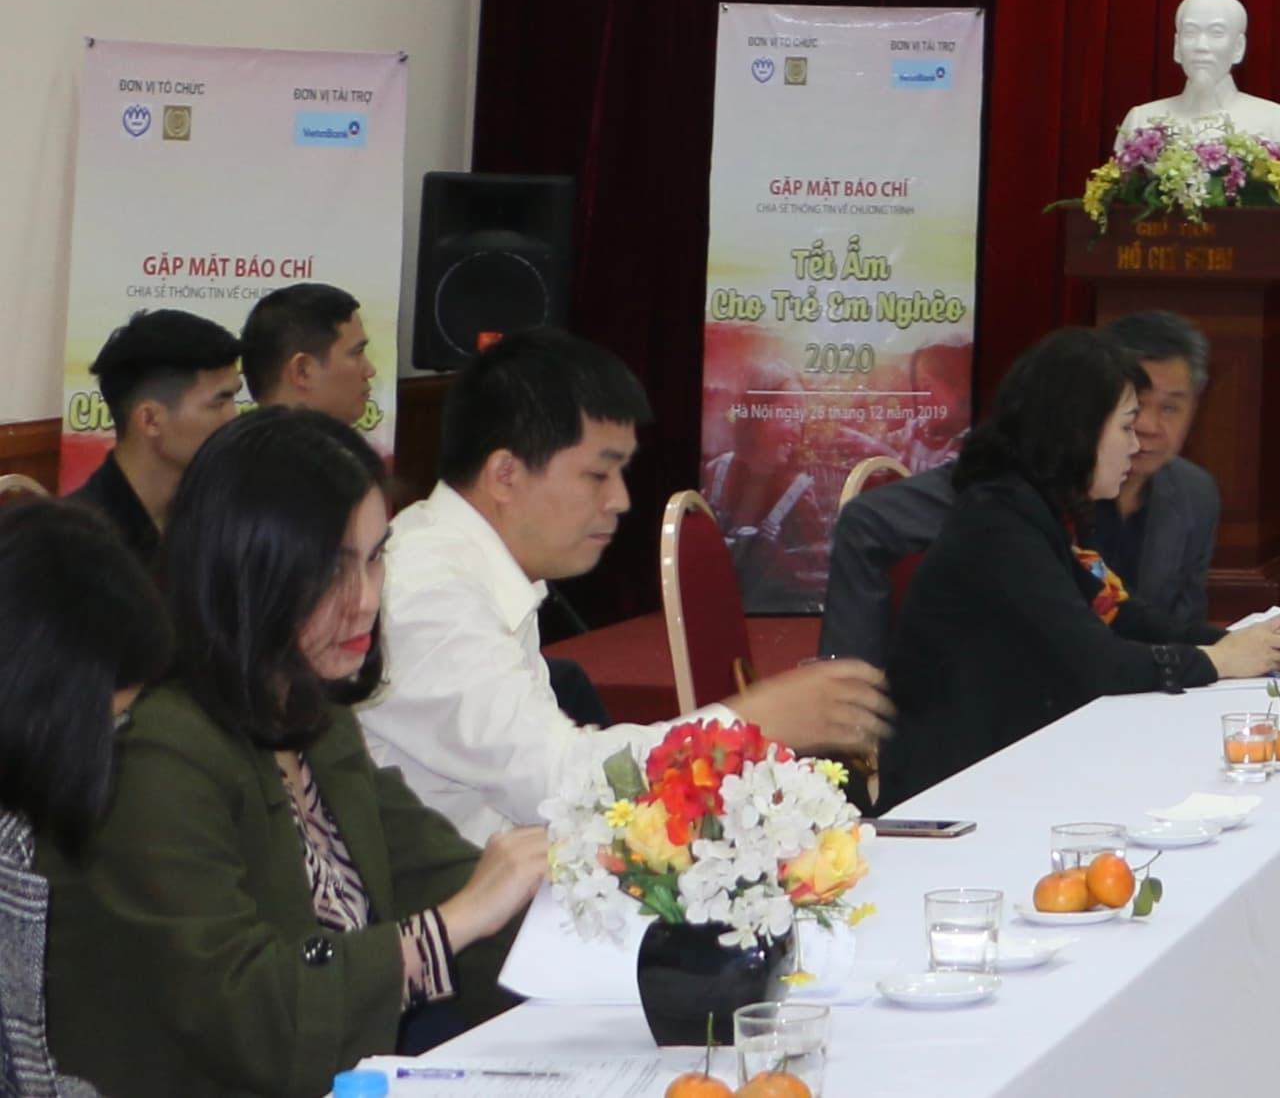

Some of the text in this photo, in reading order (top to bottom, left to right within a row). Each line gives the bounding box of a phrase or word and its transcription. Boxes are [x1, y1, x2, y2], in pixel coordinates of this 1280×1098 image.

[769, 176, 909, 201] GẶP MẶT BÁO CHÍ
[143, 252, 314, 282] GẶP MẶT BÁO CHÍ
[791, 235, 892, 281] Tết Ấm
[711, 286, 966, 329] Cho Trẻ Em Nghèo
[804, 343, 876, 374] 2020
[69, 391, 113, 432] Ch
[732, 405, 748, 418] Hà
[751, 404, 772, 421] Nội
[776, 405, 804, 422] ngày
[810, 405, 824, 418] 26
[870, 405, 885, 418] 12
[917, 405, 947, 419] 2019
